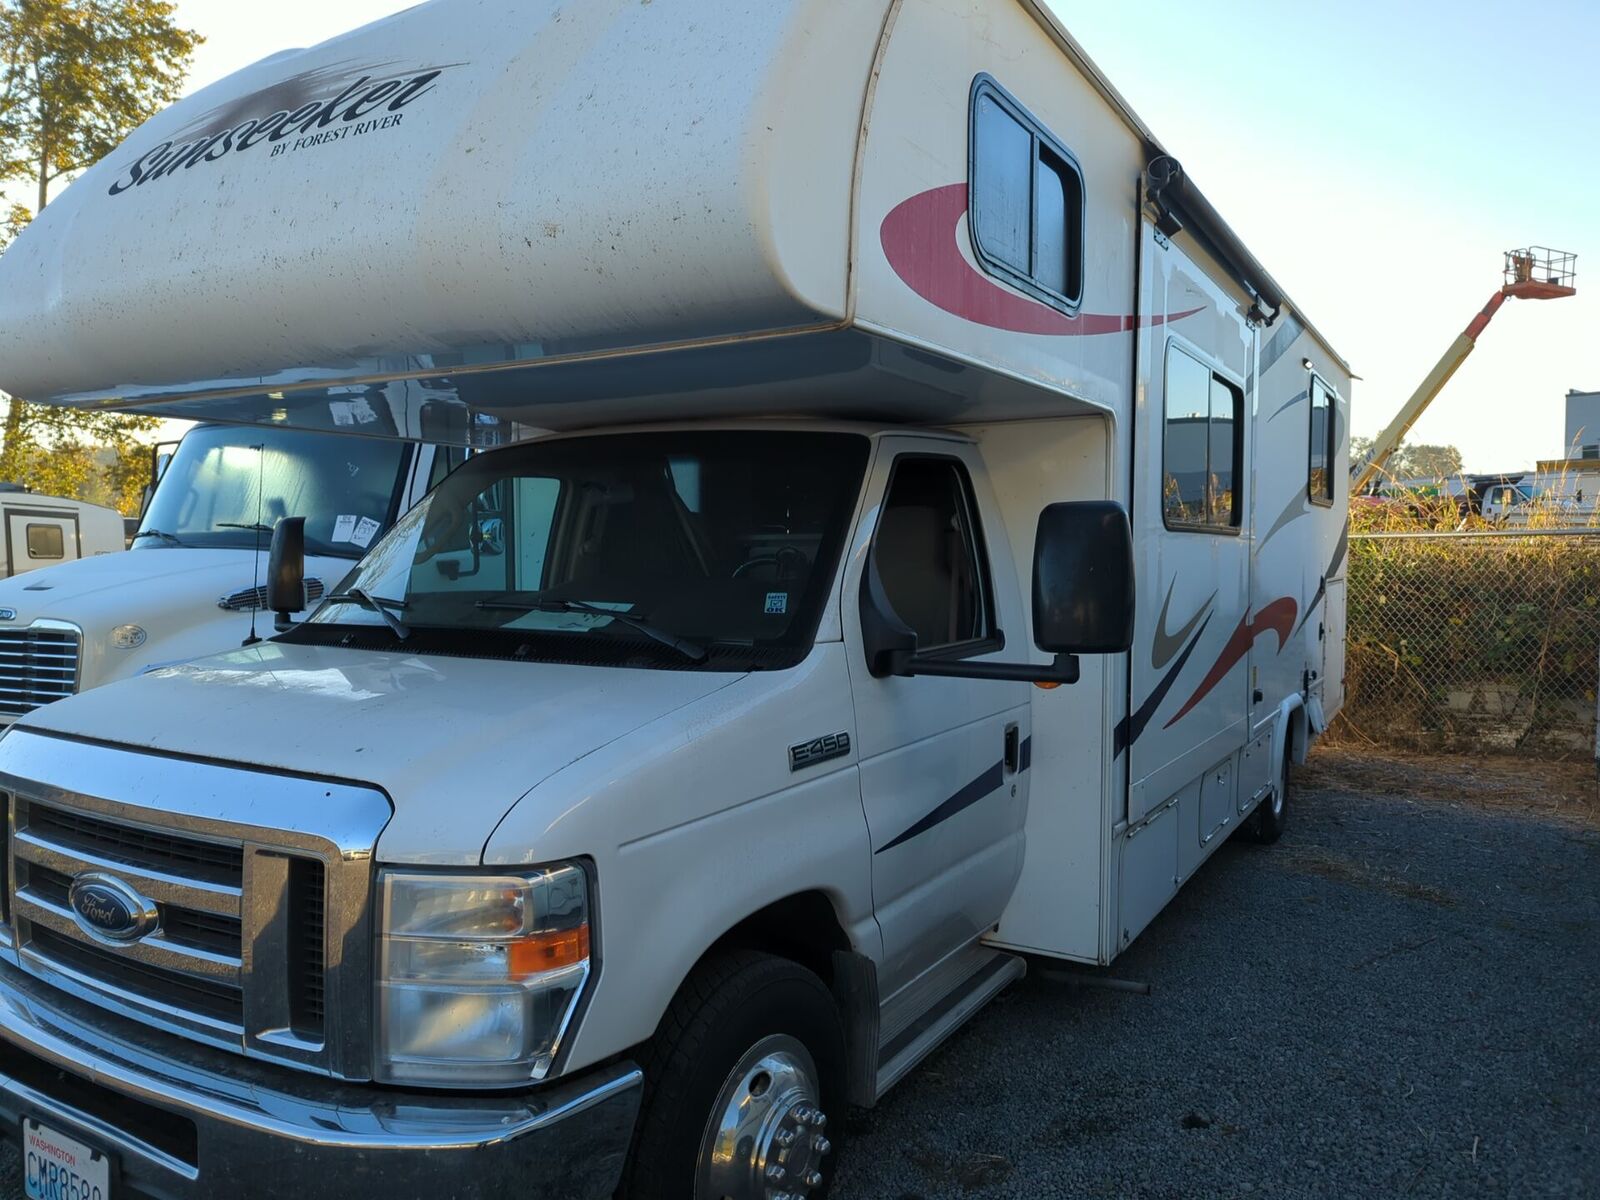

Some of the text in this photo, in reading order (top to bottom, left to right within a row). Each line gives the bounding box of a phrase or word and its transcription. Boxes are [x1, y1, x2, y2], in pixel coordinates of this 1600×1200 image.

[108, 70, 442, 196] Sunseeker
[269, 113, 403, 158] BY FOREST RIVER
[81, 892, 116, 925] Ford
[28, 1134, 76, 1167] WASHINGTON
